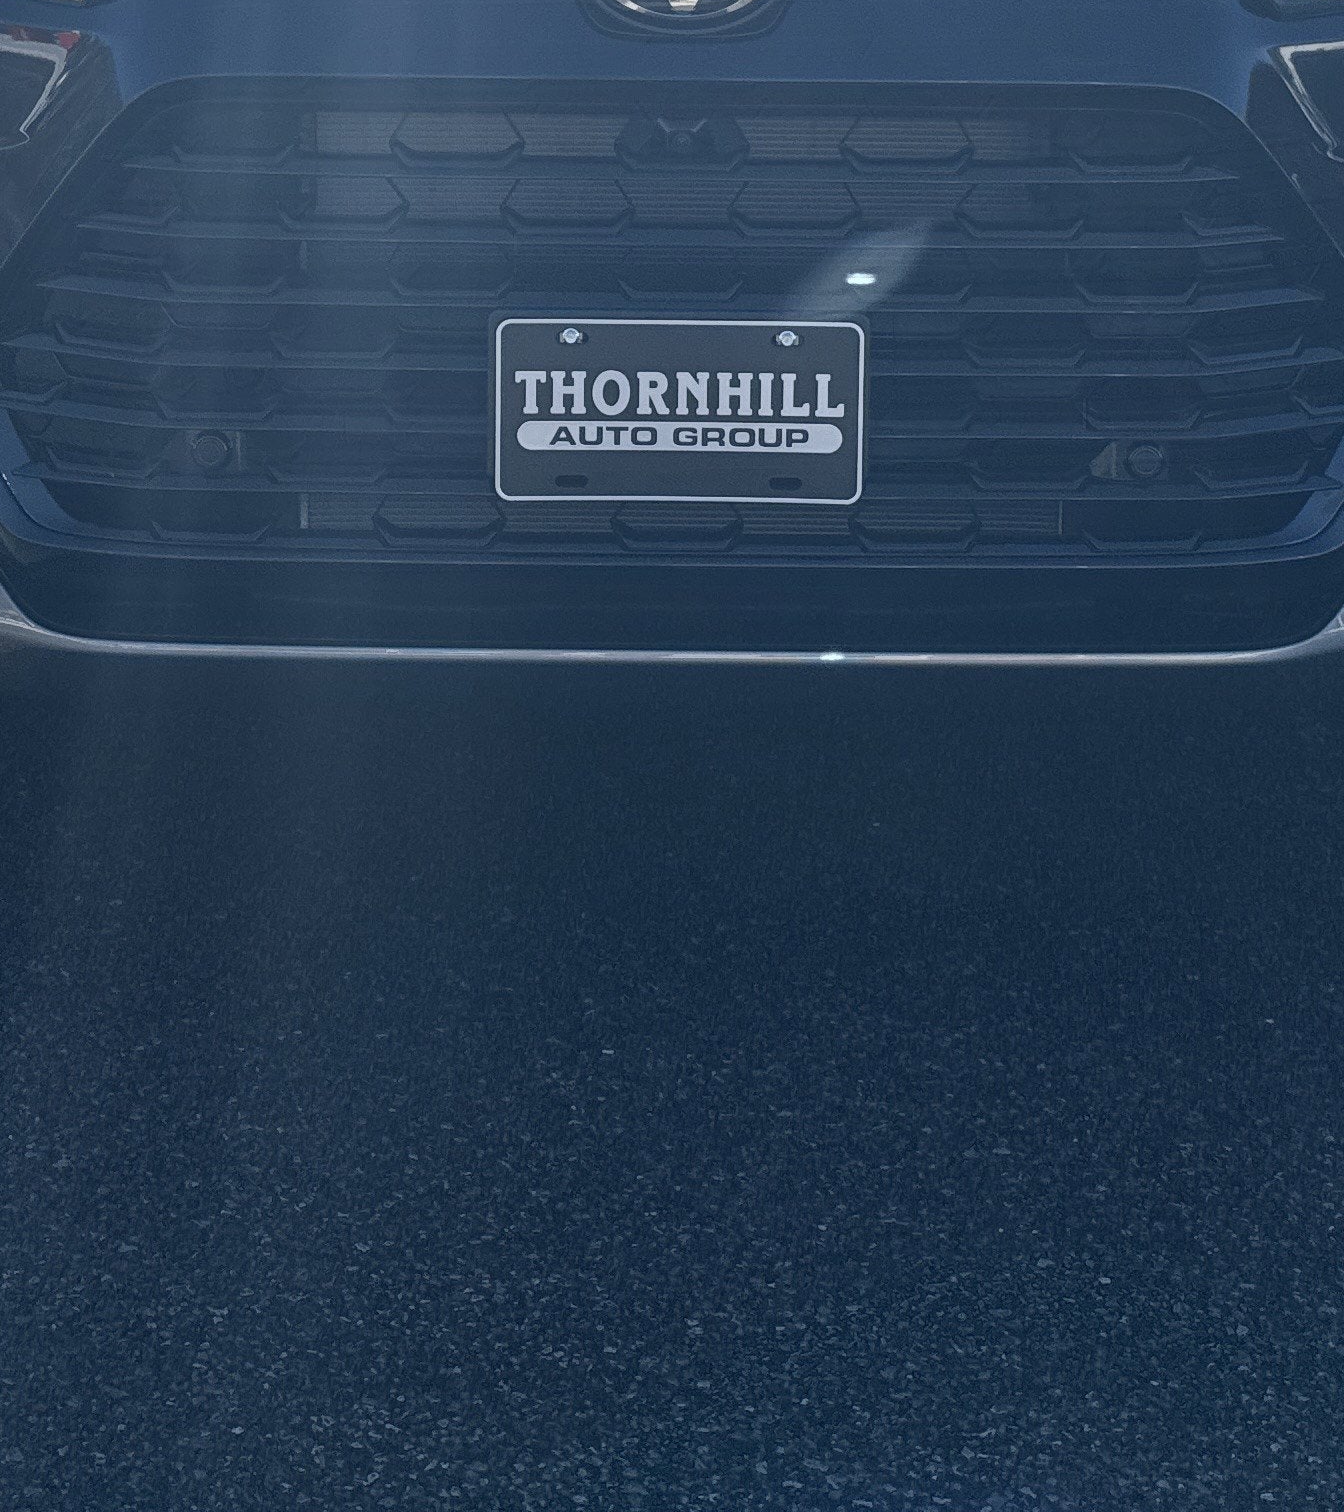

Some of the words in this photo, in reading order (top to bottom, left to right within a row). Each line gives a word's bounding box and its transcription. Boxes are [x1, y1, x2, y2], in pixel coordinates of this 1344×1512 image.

[514, 369, 845, 417] THORNHILL
[549, 426, 658, 446] AUTO
[672, 427, 810, 448] GROUP
